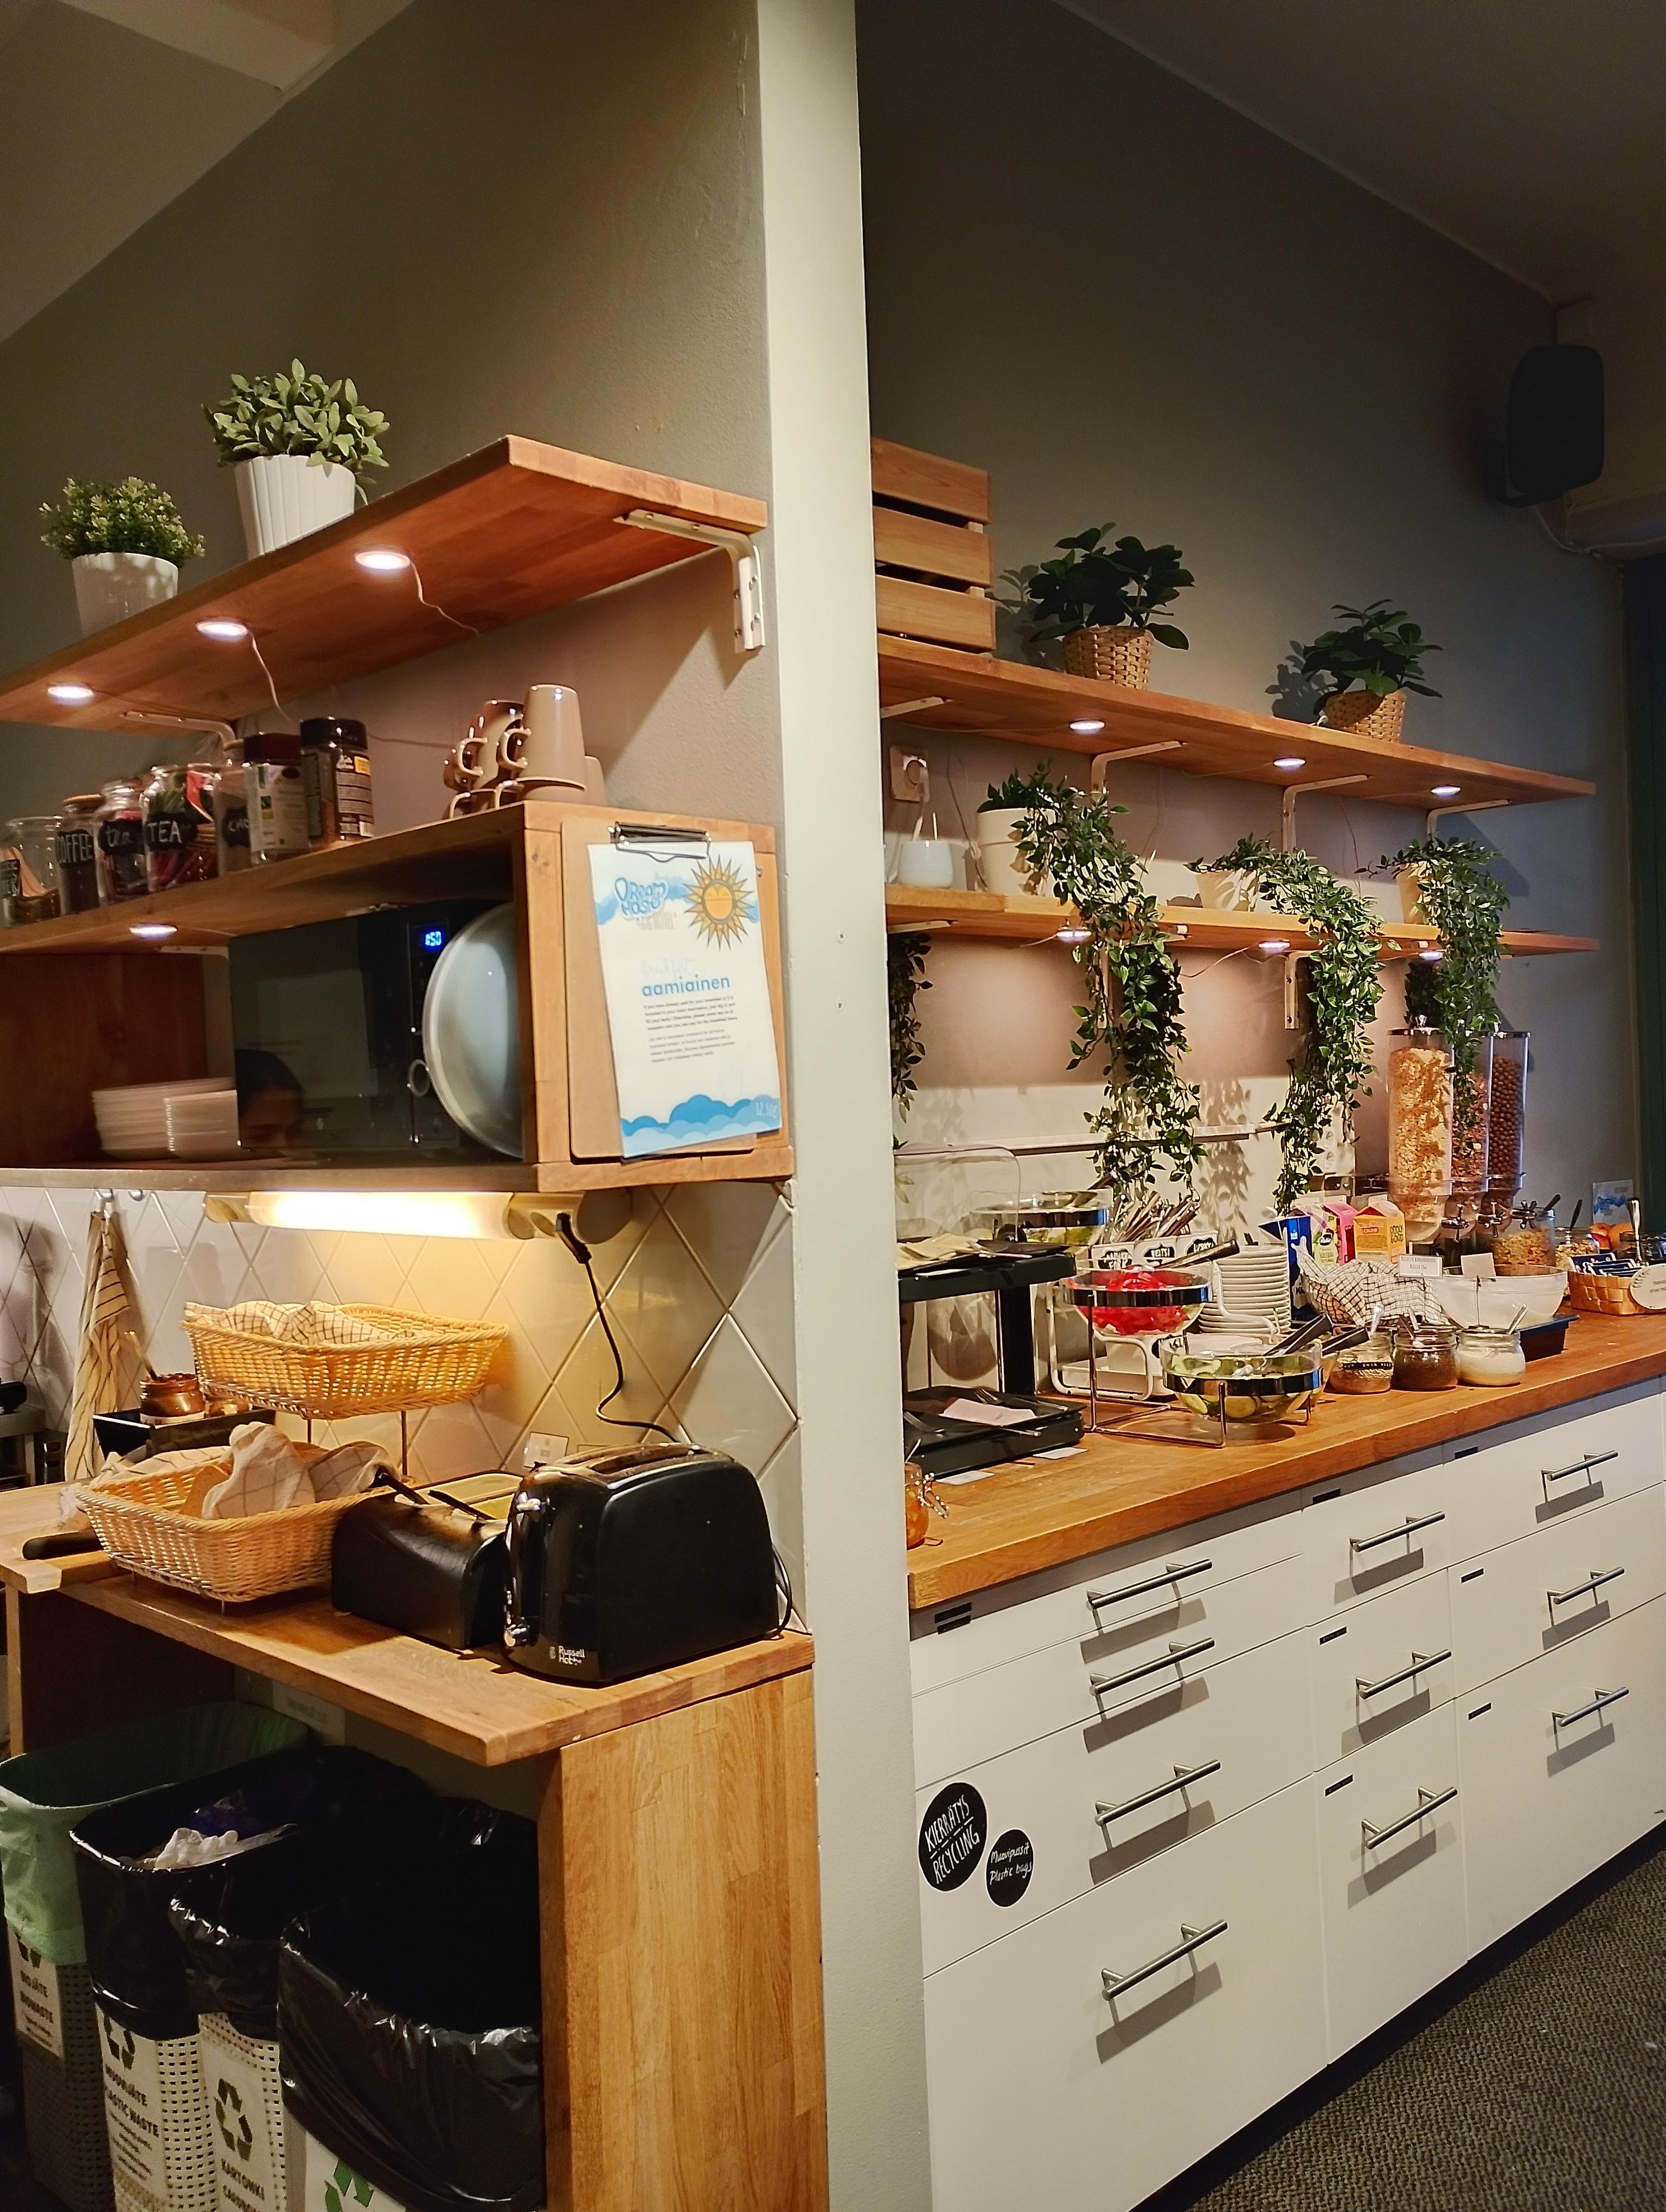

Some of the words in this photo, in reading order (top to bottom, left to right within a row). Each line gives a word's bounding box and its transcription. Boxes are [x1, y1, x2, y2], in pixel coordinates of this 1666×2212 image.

[148, 820, 183, 844] TEA
[55, 833, 94, 863] COFFEE
[642, 974, 731, 996] aamiainen
[559, 1645, 585, 1658] Russell
[925, 1795, 970, 1852] KIERRÄTYS
[933, 1824, 980, 1884] RECYCLING
[990, 1842, 1029, 1863] Muovipussit
[990, 1867, 1013, 1885] Plastic
[1016, 1861, 1032, 1879] bags
